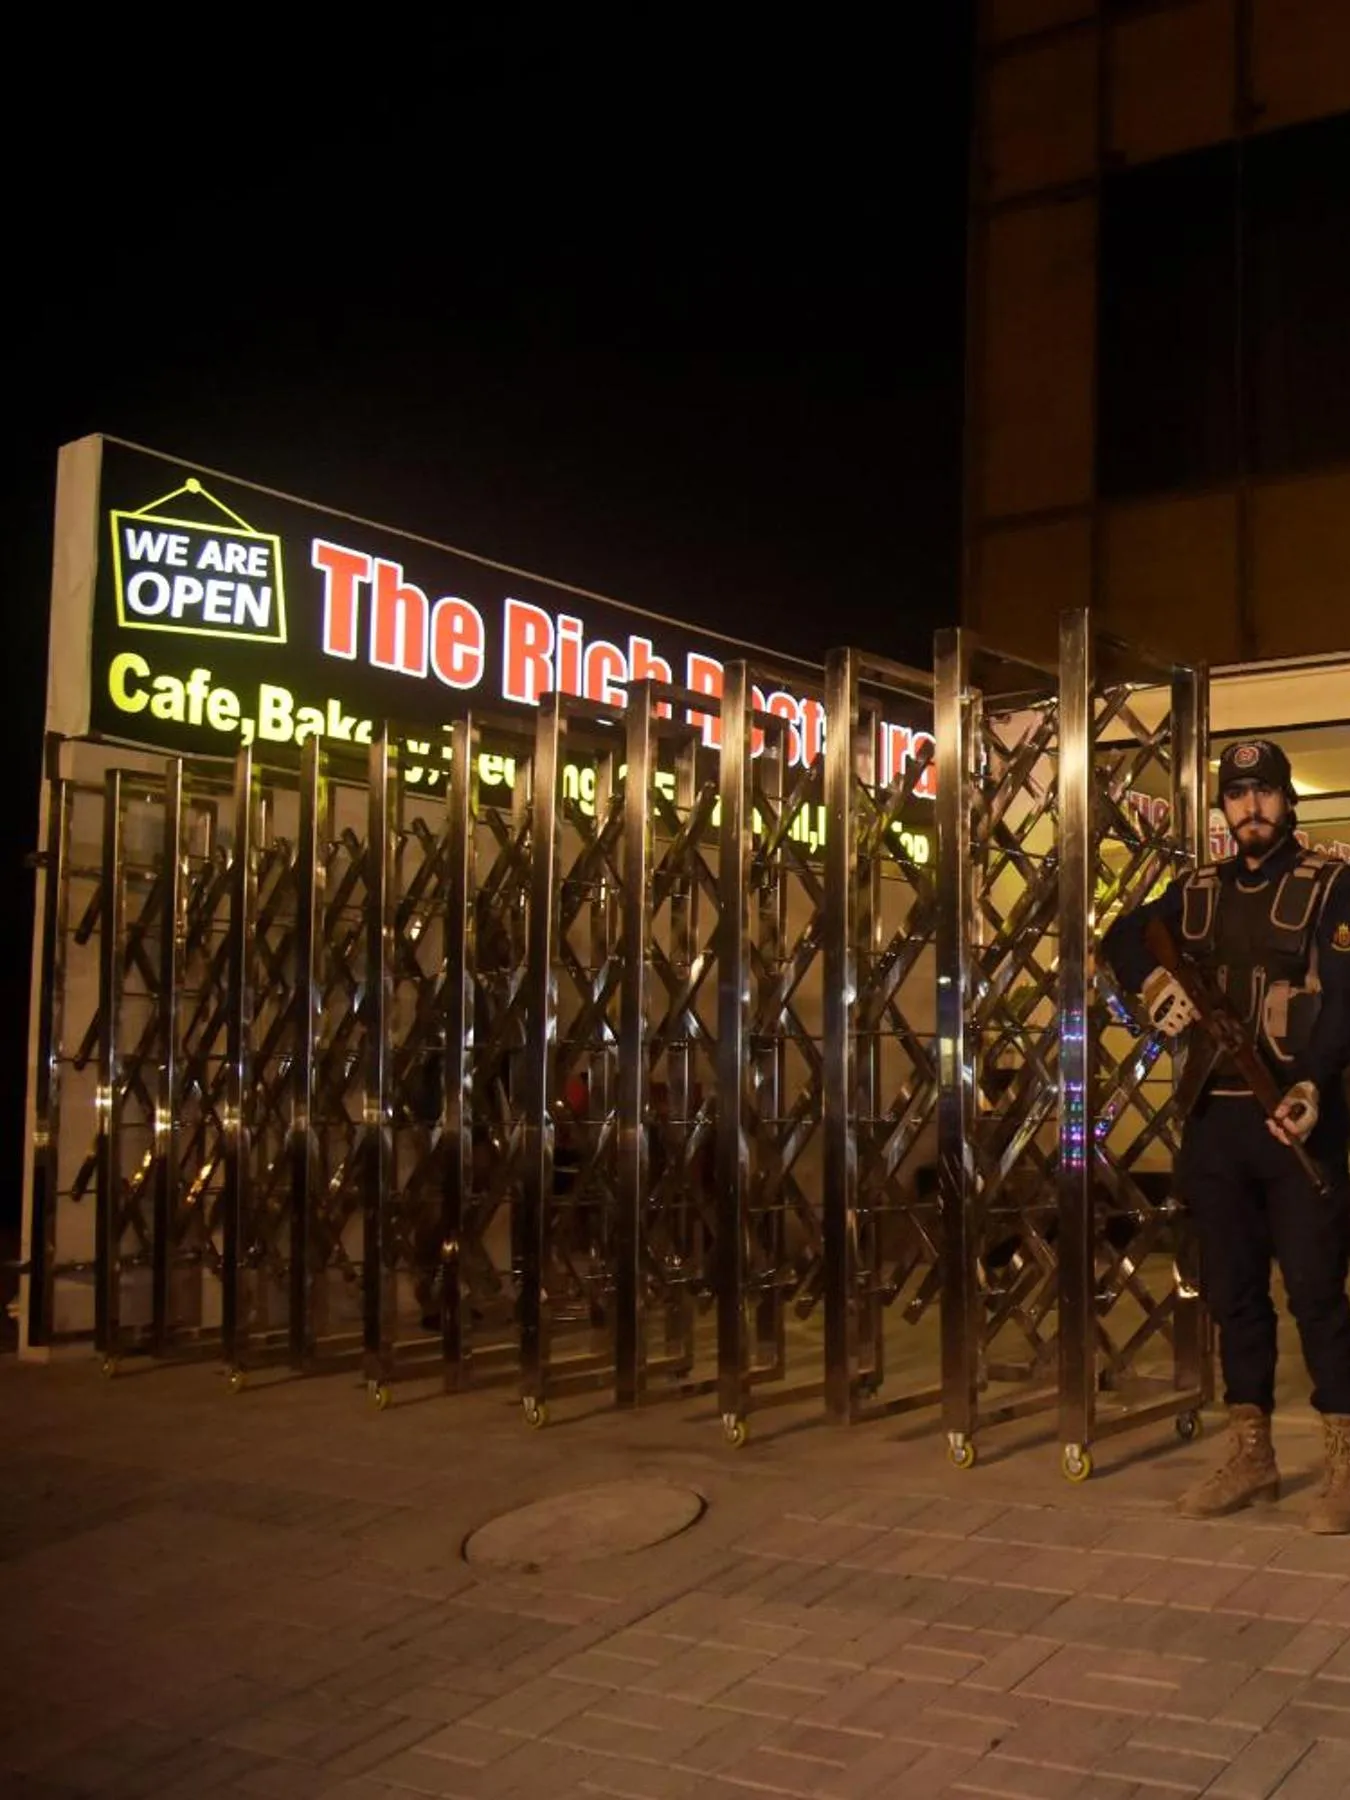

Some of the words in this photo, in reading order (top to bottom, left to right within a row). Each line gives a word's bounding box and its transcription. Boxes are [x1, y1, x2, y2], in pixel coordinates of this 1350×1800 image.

[124, 528, 190, 567] WE
[199, 538, 270, 578] ARE
[126, 571, 274, 628] OPEN
[311, 538, 487, 691] The
[502, 597, 674, 719] Rich
